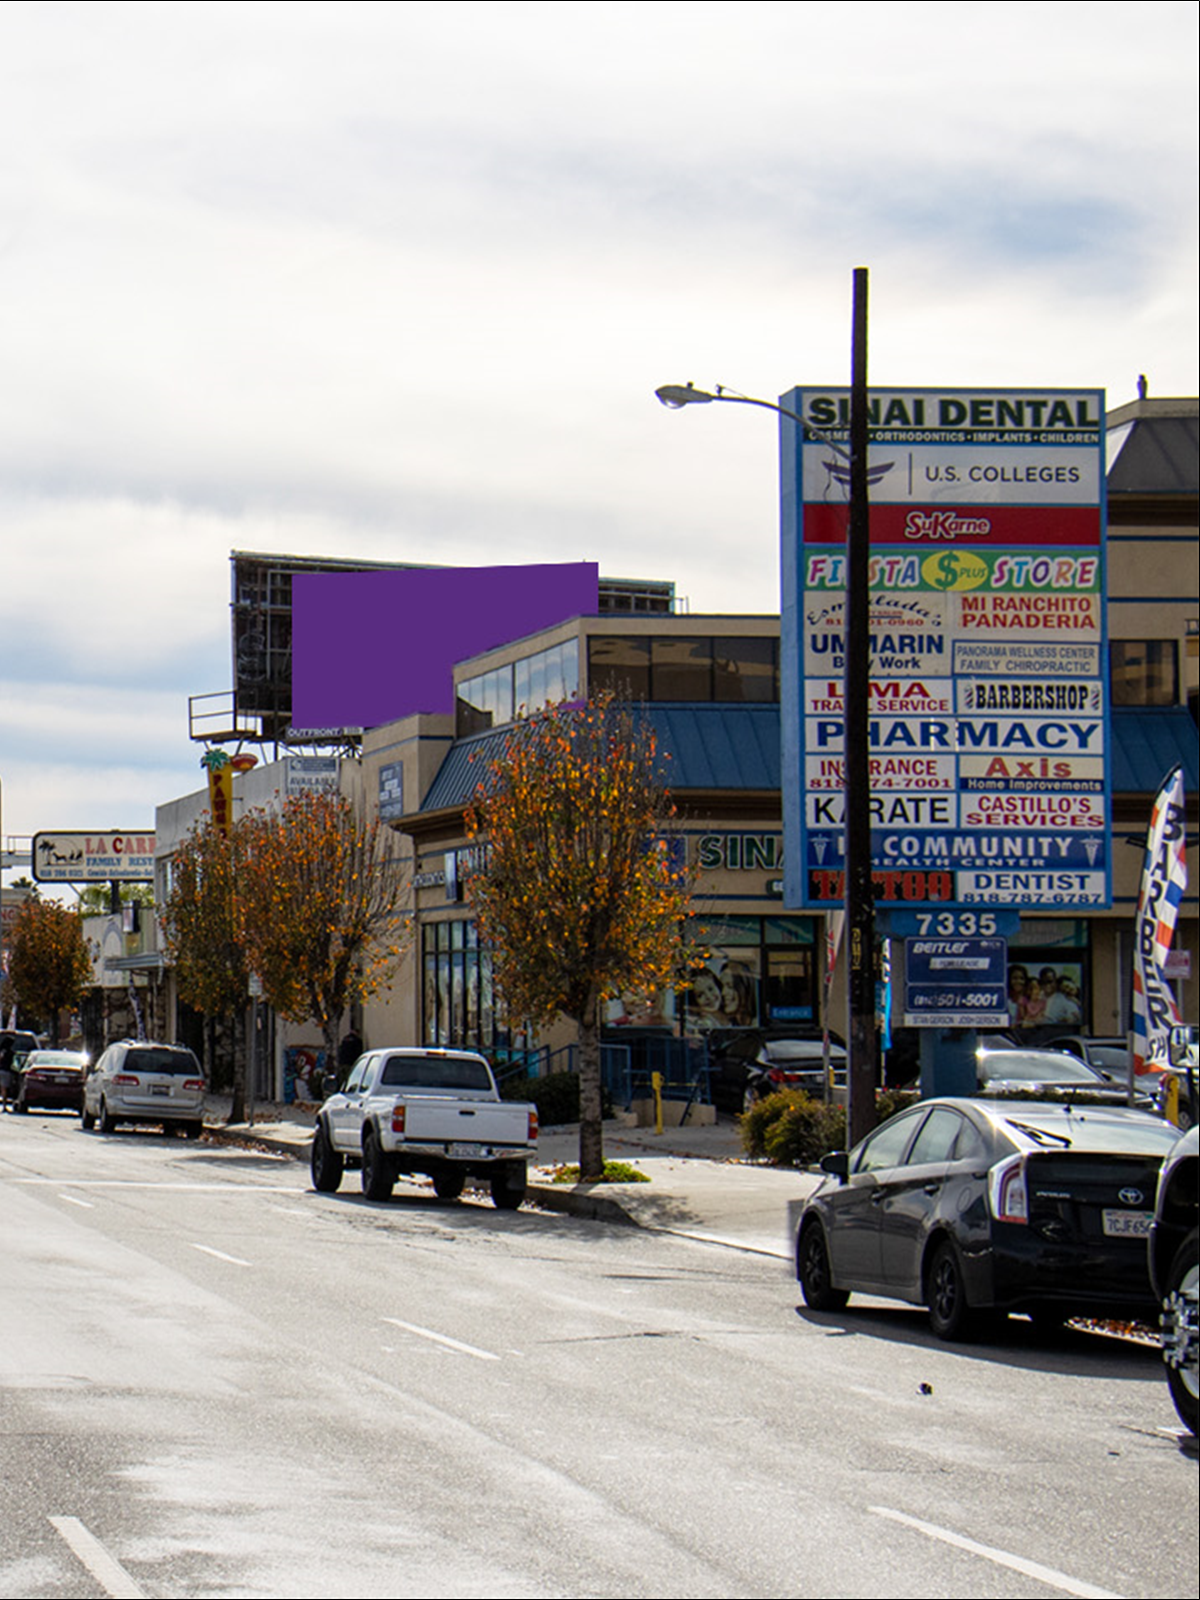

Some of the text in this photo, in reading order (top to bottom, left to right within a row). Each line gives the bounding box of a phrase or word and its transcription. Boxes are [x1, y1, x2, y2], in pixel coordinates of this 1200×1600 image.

[938, 399, 1099, 428] DENTAL
[875, 431, 965, 442] ORTHODONTICS
[973, 432, 1032, 443] IMPLANTS
[1039, 433, 1099, 444] CHILDREN
[925, 465, 1080, 483] U.S. COLLEGES
[904, 511, 991, 539] SuKarne
[806, 555, 919, 587] FISTA
[992, 556, 1098, 588] STORE
[961, 597, 1092, 612] MI RANCHITO
[961, 613, 1096, 629] PANADERIA
[811, 634, 944, 653] UNARIN
[956, 645, 1095, 660] PANORAMA WELLNESS CENTER
[879, 656, 921, 669] Work
[959, 659, 1091, 673] FAMILY CHIROPRACTIC
[827, 682, 931, 698] LMA
[975, 684, 1089, 711] BARBERSHOP
[877, 700, 949, 712] SERVICE
[820, 759, 938, 776] INRANCE
[985, 757, 1072, 778] Axis
[968, 779, 1102, 791] Home Improvements
[814, 797, 950, 823] KRATE
[978, 796, 1092, 813] CASTILLO'S
[966, 812, 1105, 827] SERVICES
[85, 837, 108, 854] LA
[699, 834, 784, 869] SIN
[883, 836, 1073, 857] COMMUNITY
[960, 858, 1046, 867] CENTER
[974, 874, 1091, 890] DENTIST
[963, 893, 1103, 904] 818-787-6787
[916, 912, 997, 936] 7335
